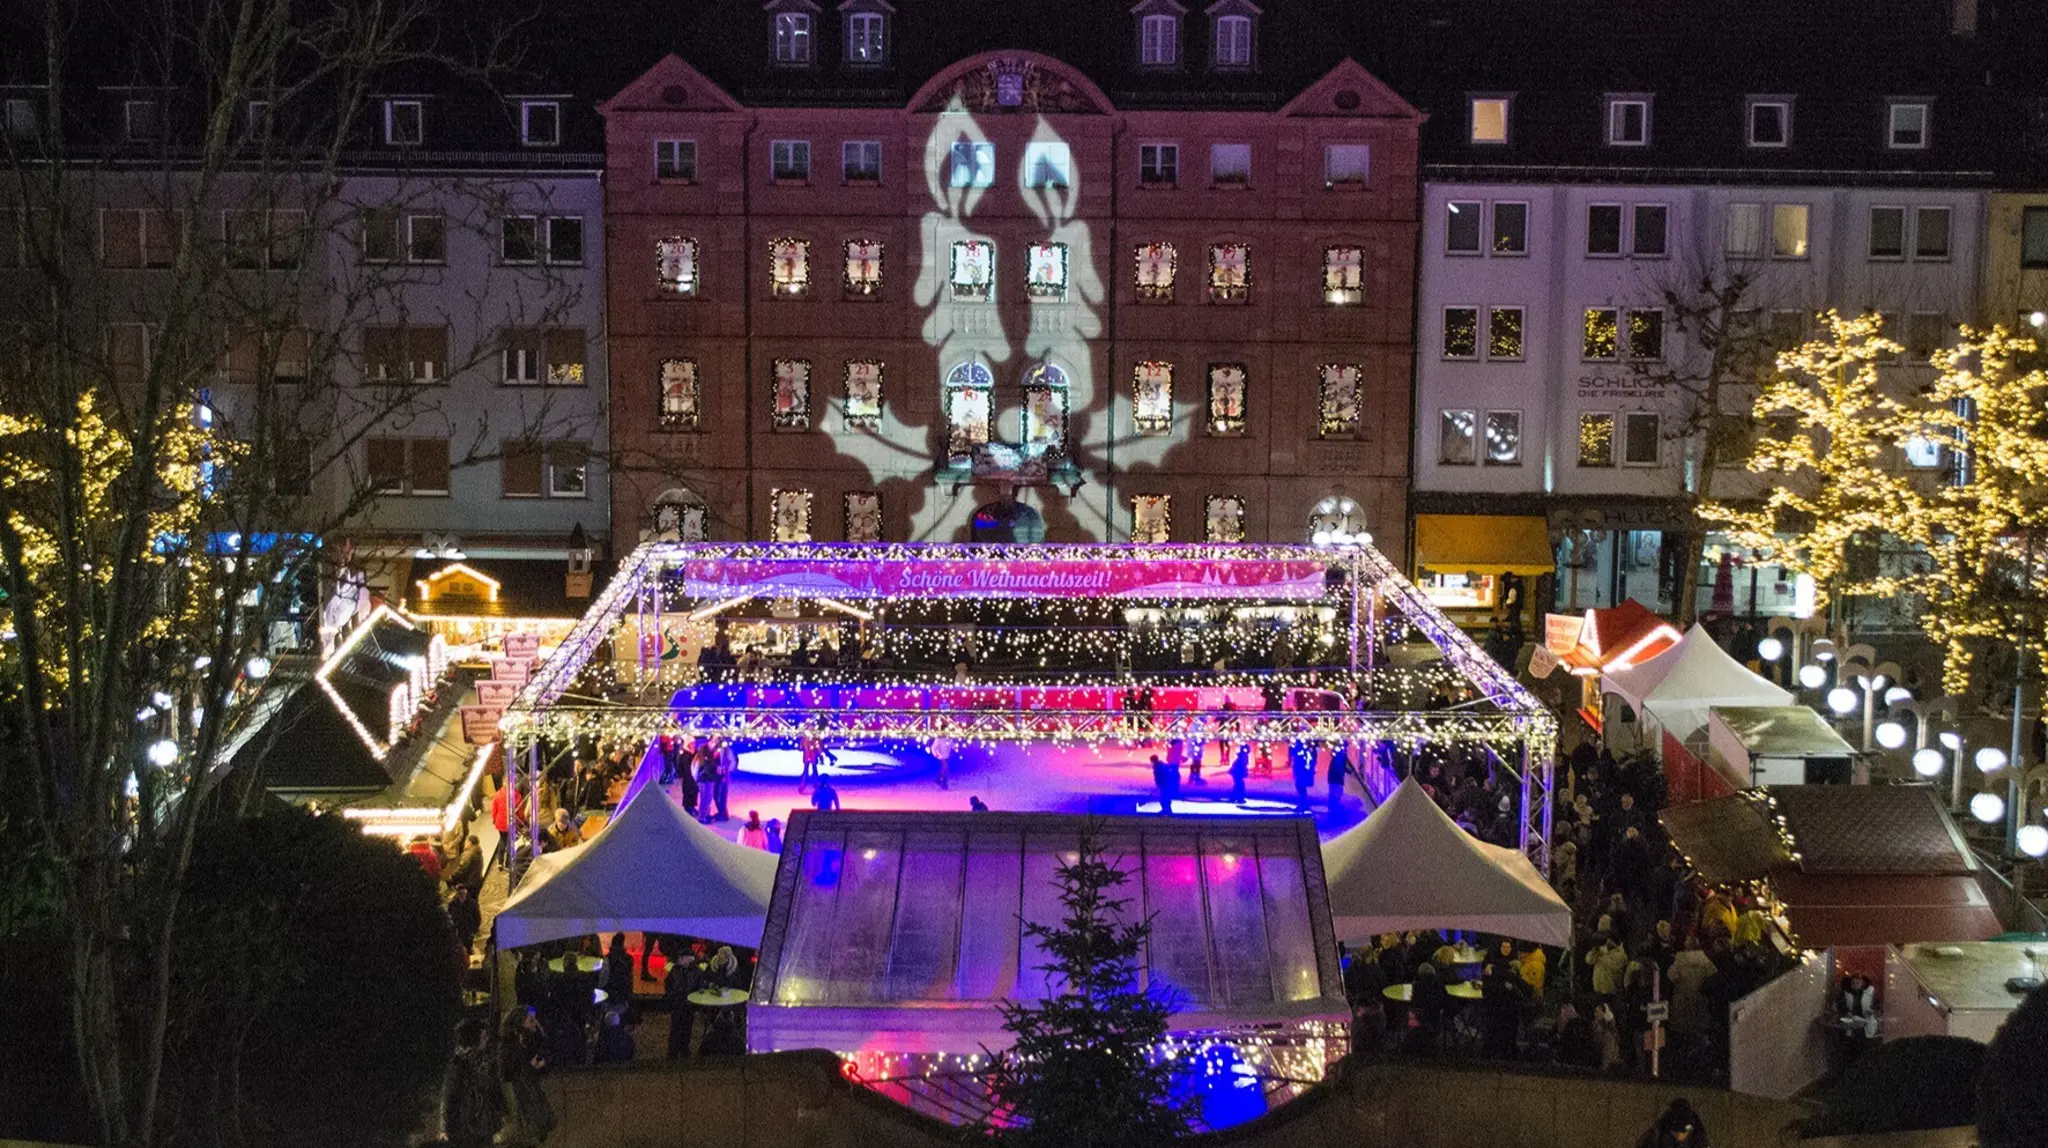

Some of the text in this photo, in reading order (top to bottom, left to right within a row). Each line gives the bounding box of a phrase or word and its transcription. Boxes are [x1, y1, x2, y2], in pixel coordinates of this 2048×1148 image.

[669, 243, 685, 255] 20
[1578, 390, 1665, 398] DIE FRISEURE
[899, 568, 1113, 588] Schöne Weihnachtszeit!
